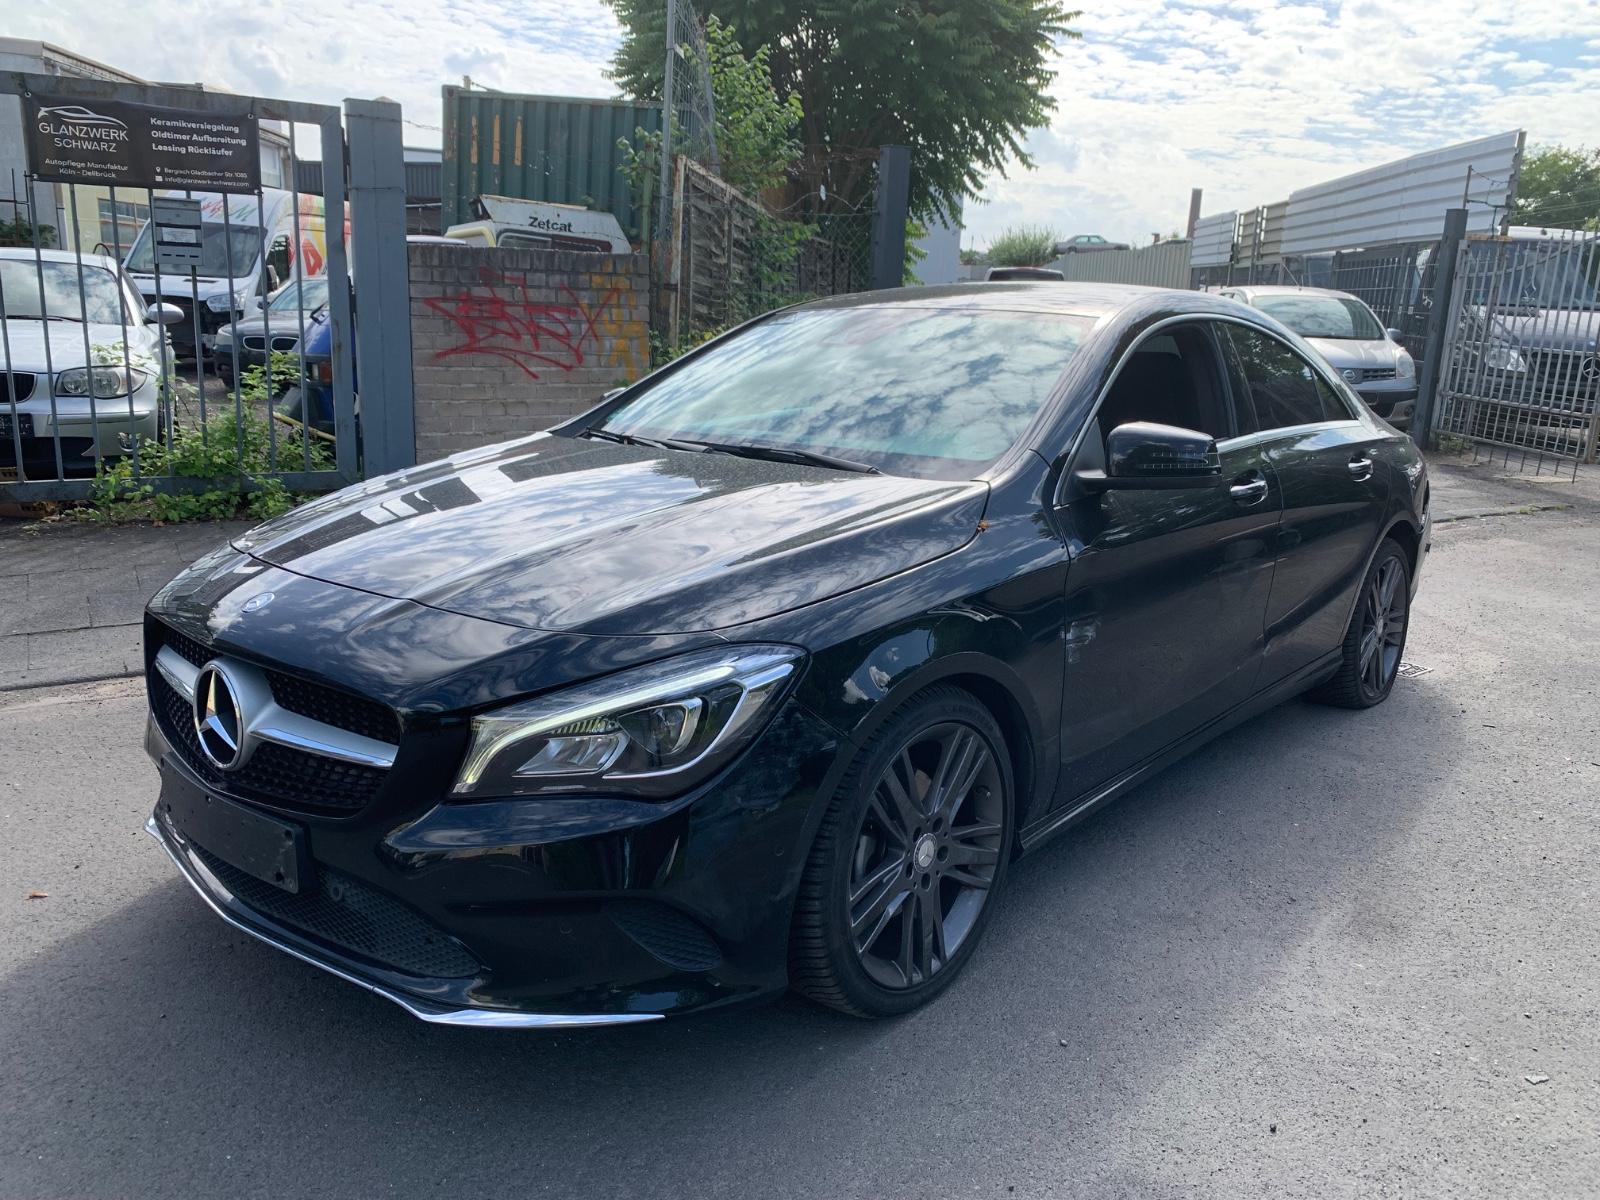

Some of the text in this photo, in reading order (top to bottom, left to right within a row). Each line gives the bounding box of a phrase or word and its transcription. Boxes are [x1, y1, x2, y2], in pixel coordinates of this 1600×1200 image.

[38, 122, 129, 142] GLANZWERK
[150, 117, 240, 134] Keramikversiegelung
[54, 137, 117, 153] SCHWARZ
[151, 130, 247, 146] Oldtimer Aufbereitung
[152, 143, 233, 156] Leasing Rückläufer
[45, 158, 128, 171] Autopflege Manufaktur
[59, 167, 75, 175] Köln
[528, 215, 574, 233] Zetcat
